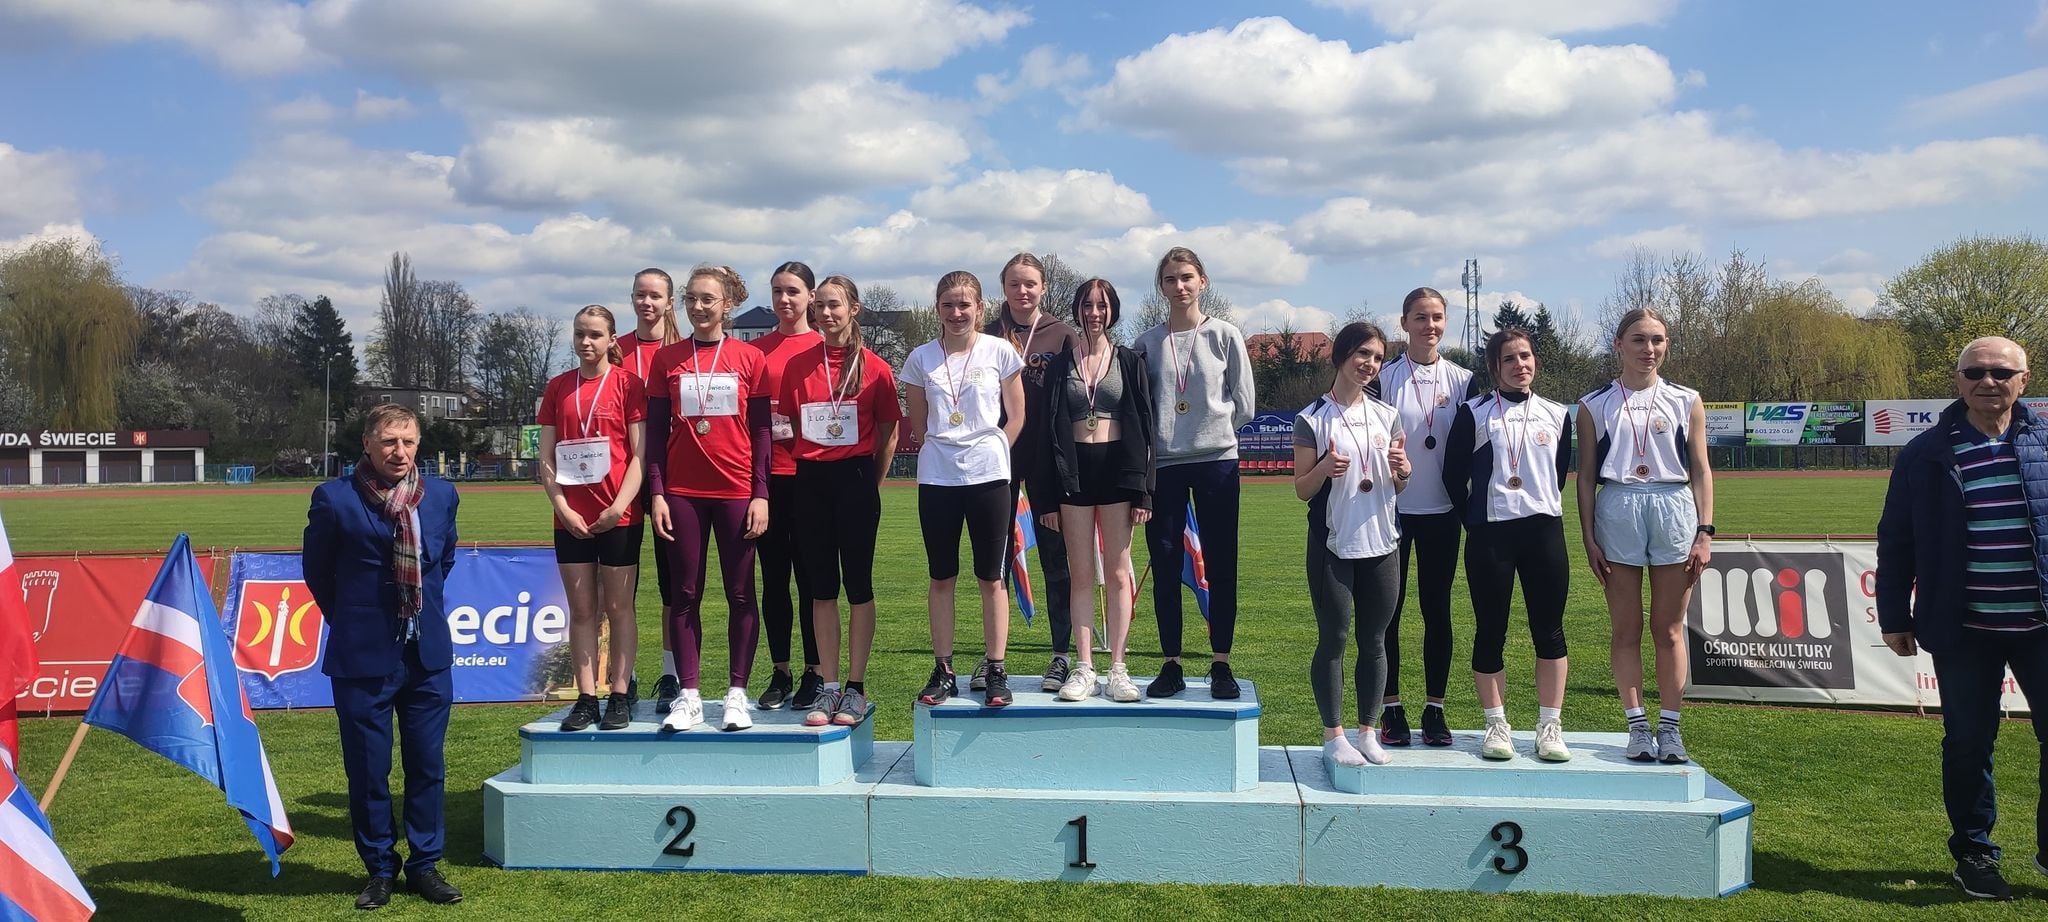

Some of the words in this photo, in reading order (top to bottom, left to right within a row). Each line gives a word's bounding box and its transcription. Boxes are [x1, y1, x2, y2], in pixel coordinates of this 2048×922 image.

[1749, 405, 1806, 421] HAS
[1906, 412, 1932, 424] TK
[0, 433, 31, 446] DA
[39, 430, 116, 446] ŚWIECIE
[1704, 639, 1767, 657] OŚRODEK
[1769, 642, 1833, 659] KULTURY
[1706, 658, 1737, 667] SPORTU
[1738, 659, 1742, 668] I
[1744, 659, 1786, 669] REKREACJI
[1787, 660, 1796, 669] W
[1798, 658, 1833, 670] ŚWIECIU
[15, 669, 97, 698] cie
[662, 806, 696, 856] 2
[1068, 815, 1096, 868] 1
[1491, 821, 1528, 874] 3
